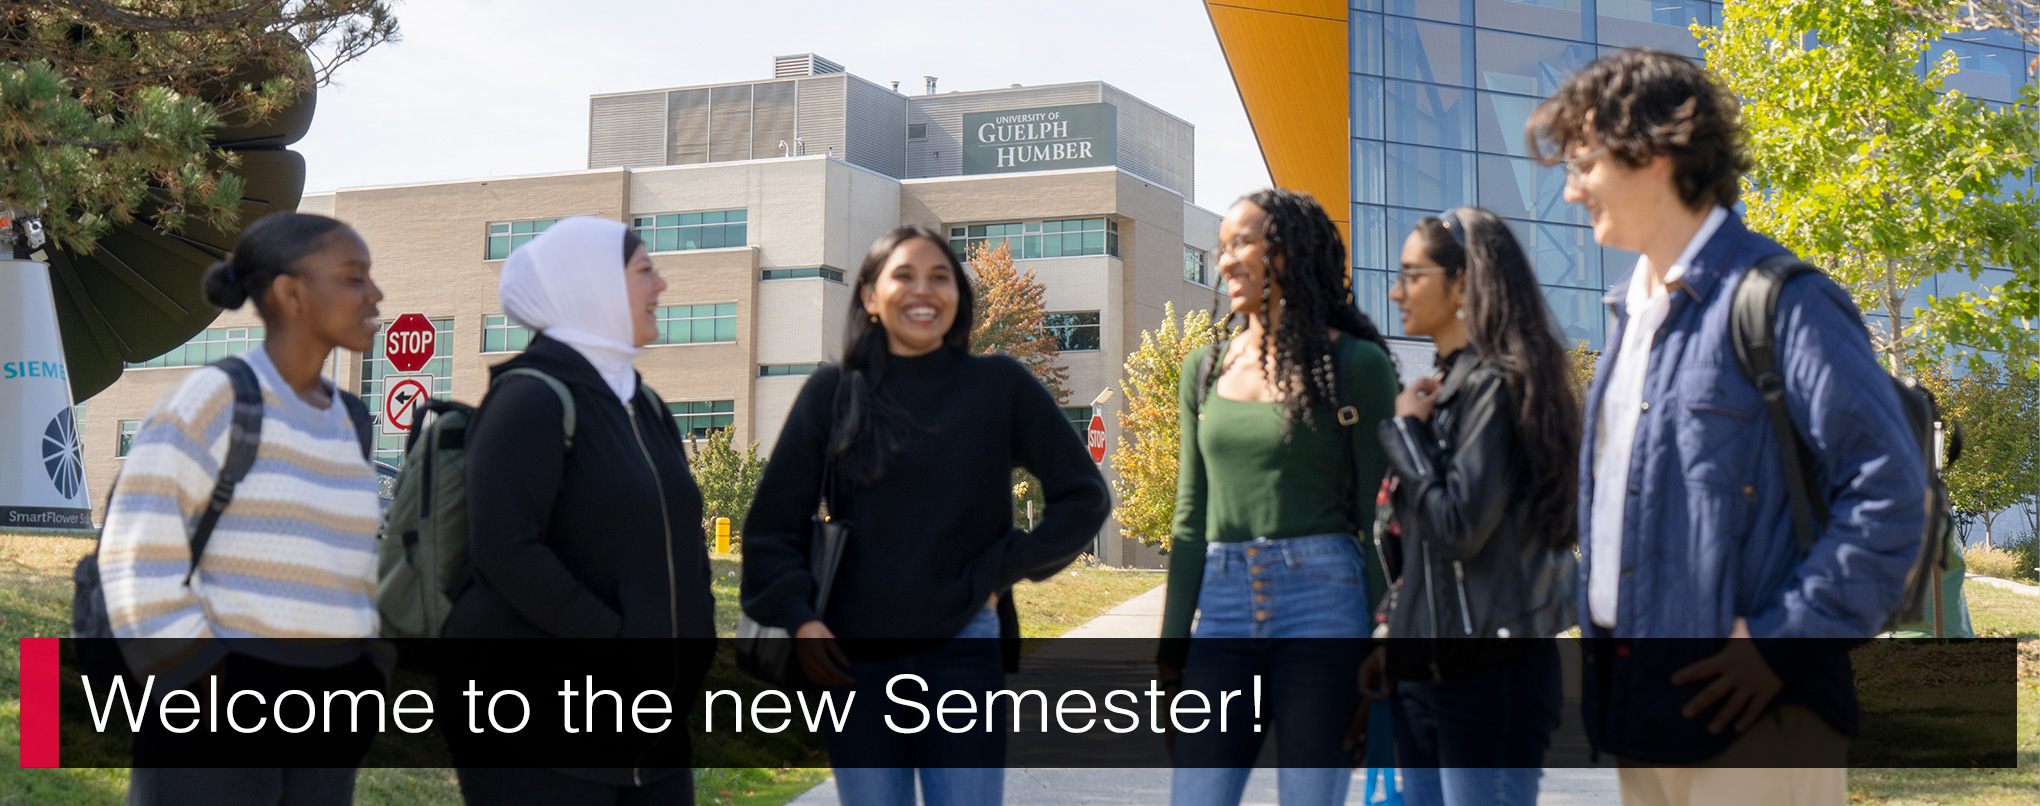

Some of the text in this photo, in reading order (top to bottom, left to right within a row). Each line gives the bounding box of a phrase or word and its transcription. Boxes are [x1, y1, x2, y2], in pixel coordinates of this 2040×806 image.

[996, 112, 1060, 125] UNIVERSITY OF
[978, 120, 1068, 143] GUELPH
[996, 141, 1093, 168] HUMBER
[388, 331, 433, 354] STOP
[1089, 429, 1105, 448] STOP
[9, 510, 79, 524] SmartFlower
